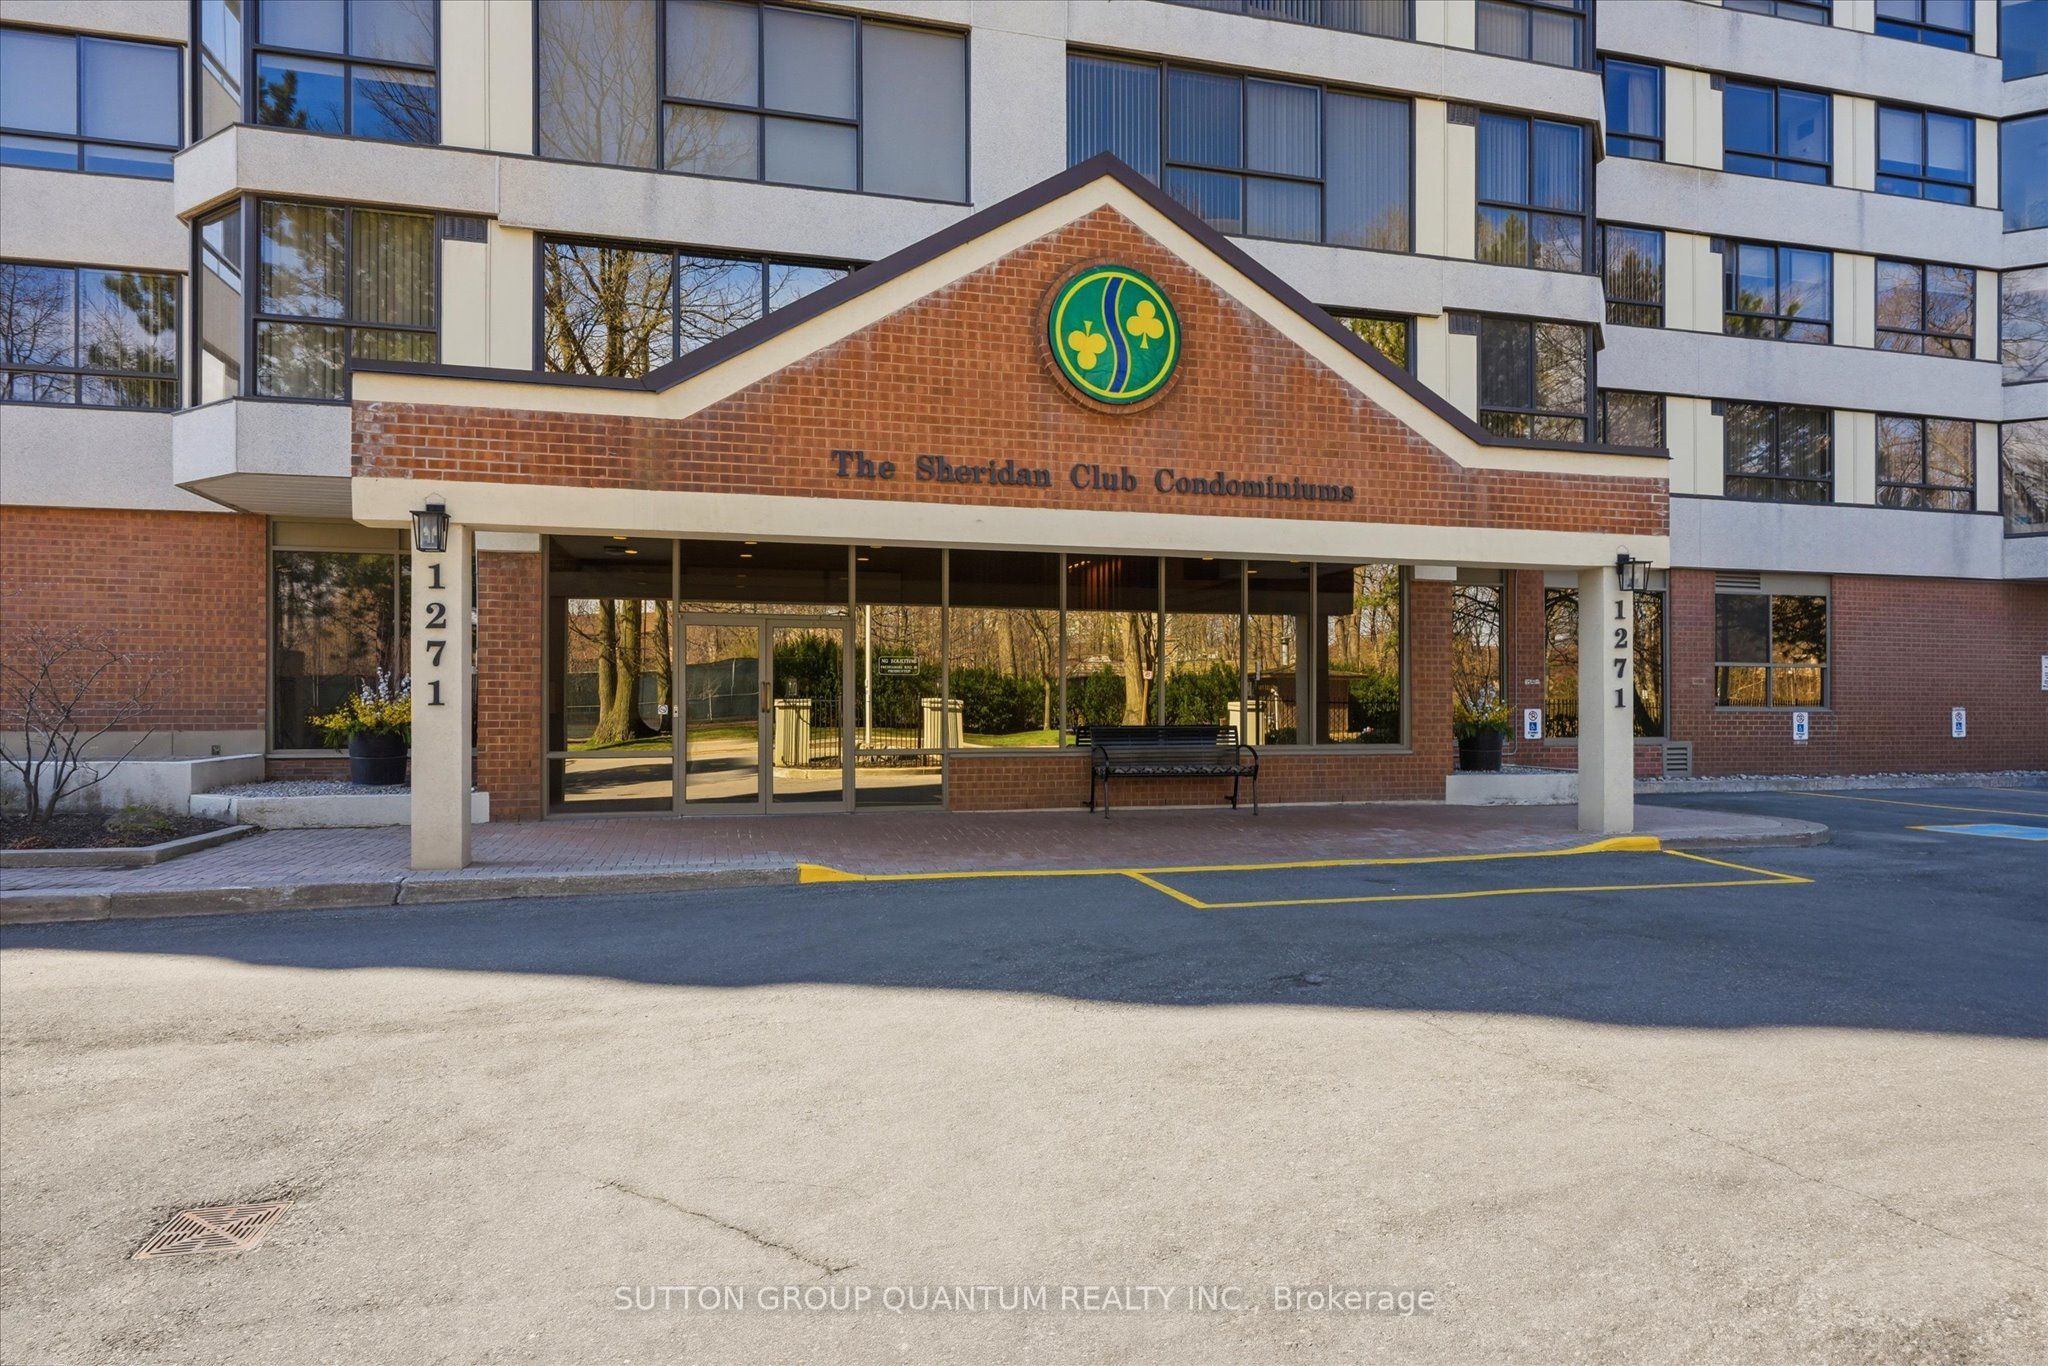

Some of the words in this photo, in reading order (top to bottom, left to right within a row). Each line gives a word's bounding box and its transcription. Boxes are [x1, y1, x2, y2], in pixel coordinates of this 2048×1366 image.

[832, 449, 896, 480] The
[916, 454, 1052, 488] Sheridan
[1070, 463, 1138, 492] Club
[1153, 468, 1355, 502] Condominiums
[425, 563, 447, 706] 1271
[1614, 599, 1628, 708] 1271
